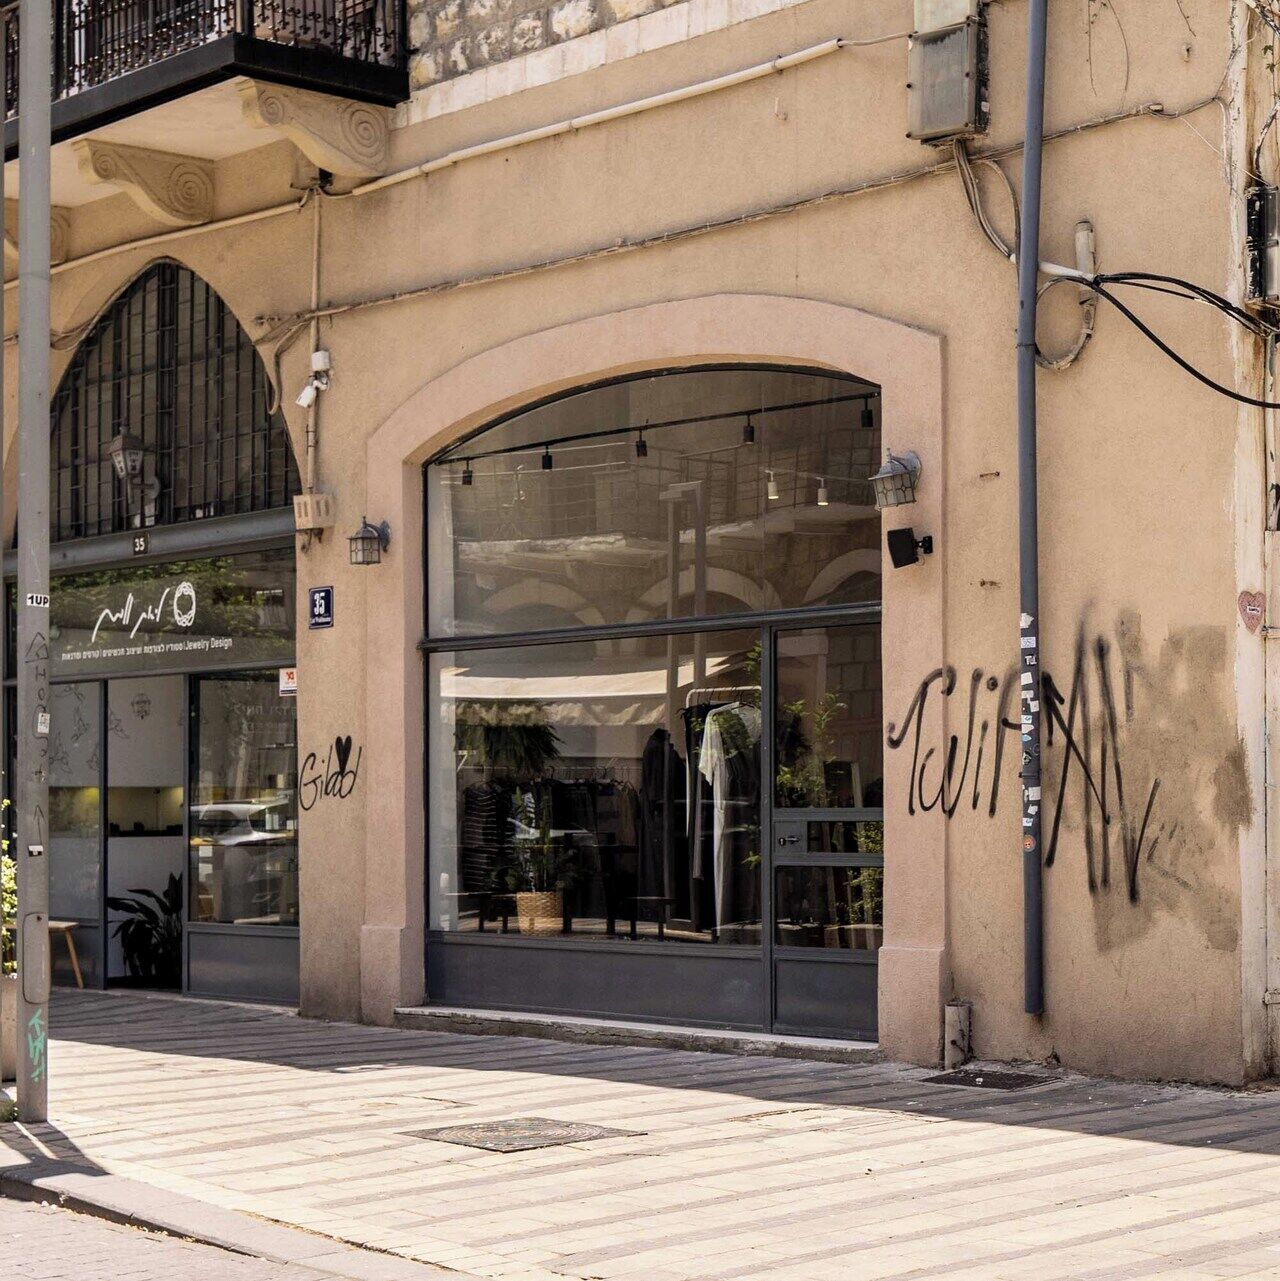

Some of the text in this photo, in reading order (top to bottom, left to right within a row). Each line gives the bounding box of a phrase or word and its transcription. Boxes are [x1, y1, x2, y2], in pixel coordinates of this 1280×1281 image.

[134, 537, 145, 552] 35
[28, 595, 49, 606] 1UP
[314, 592, 326, 615] 35
[185, 637, 233, 651] Jewelry Design
